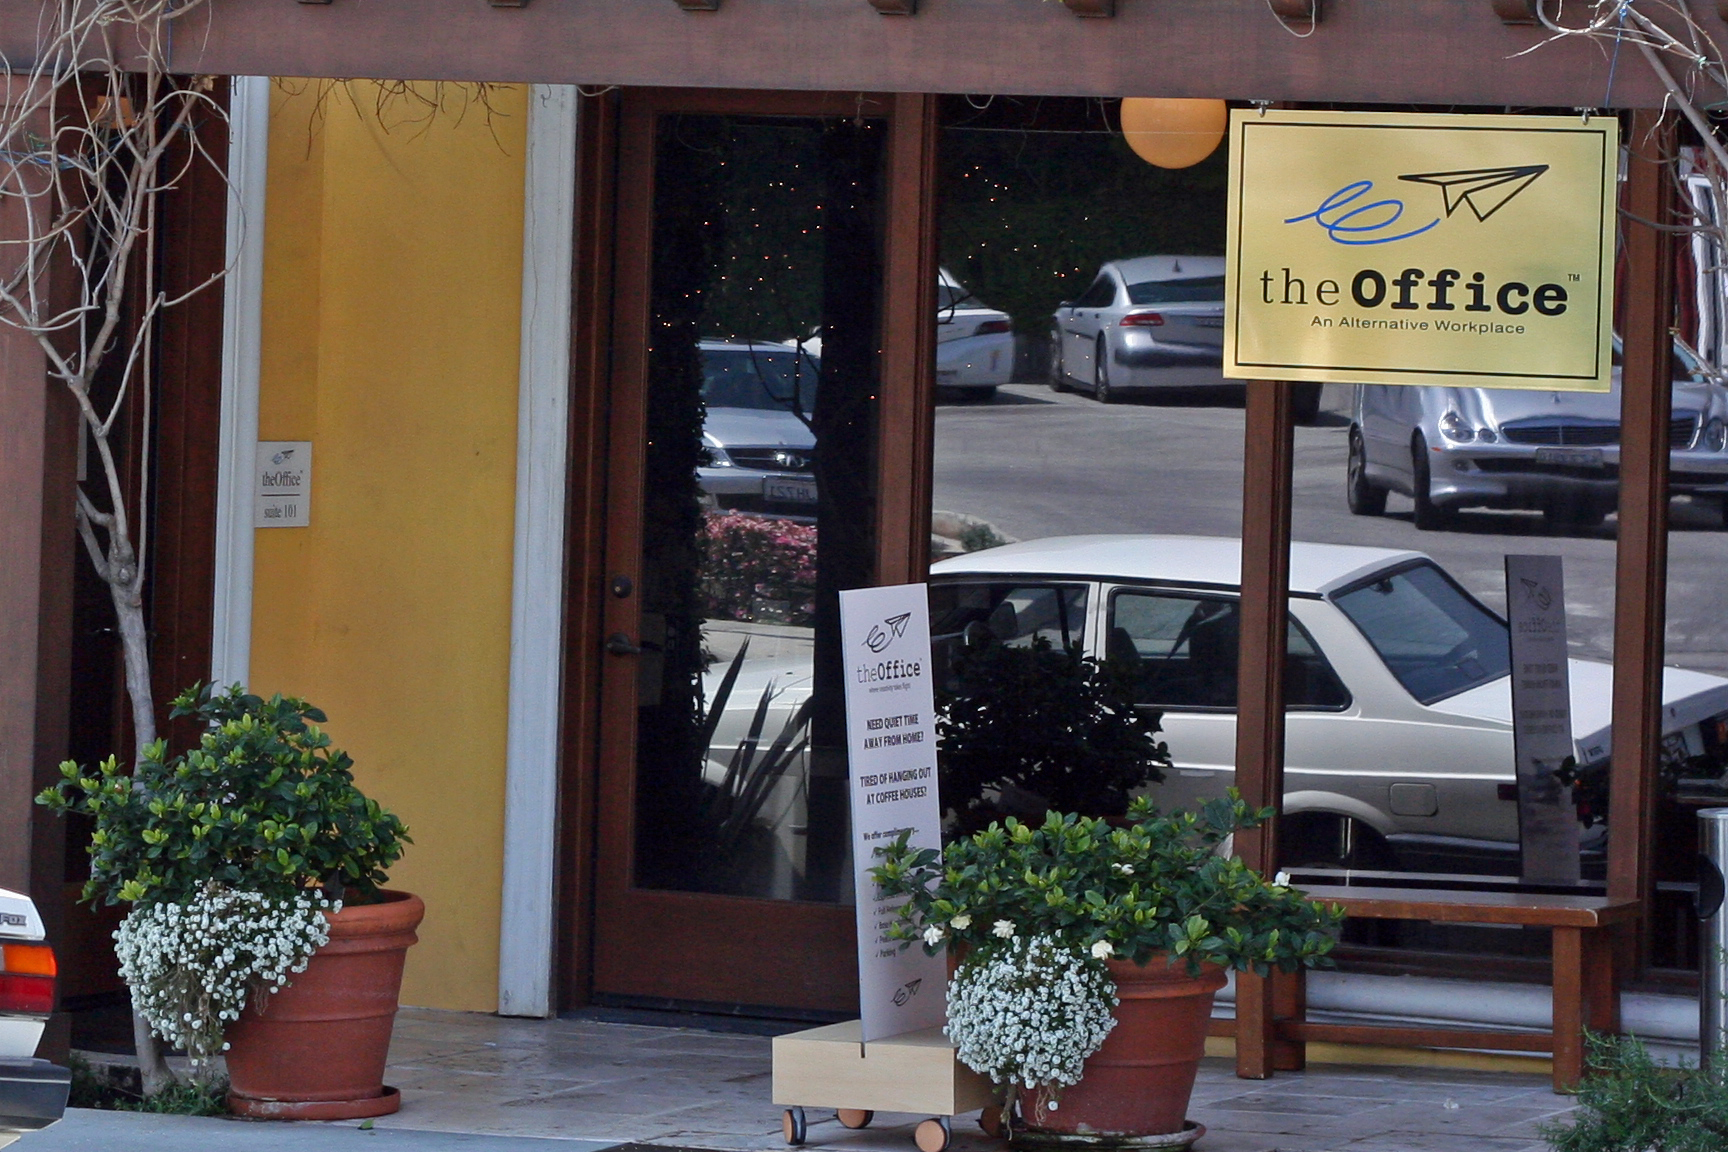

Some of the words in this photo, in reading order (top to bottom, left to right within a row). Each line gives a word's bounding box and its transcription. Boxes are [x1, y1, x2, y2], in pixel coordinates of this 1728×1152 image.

[1310, 315, 1333, 328] An
[1338, 315, 1429, 331] Alternative
[1434, 319, 1526, 336] Workplace
[284, 504, 297, 518] 101
[856, 660, 921, 684] theOffice
[866, 718, 883, 731] NEED
[884, 715, 903, 730] QUIET
[904, 713, 919, 727] TIME
[864, 736, 883, 750] AWAY
[884, 734, 902, 747] FROM
[860, 774, 879, 788] TIRED
[880, 772, 888, 785] OF
[888, 769, 918, 784] HANGING
[918, 767, 932, 780] OUT
[866, 793, 875, 805] AT
[876, 789, 899, 804] COFFEE
